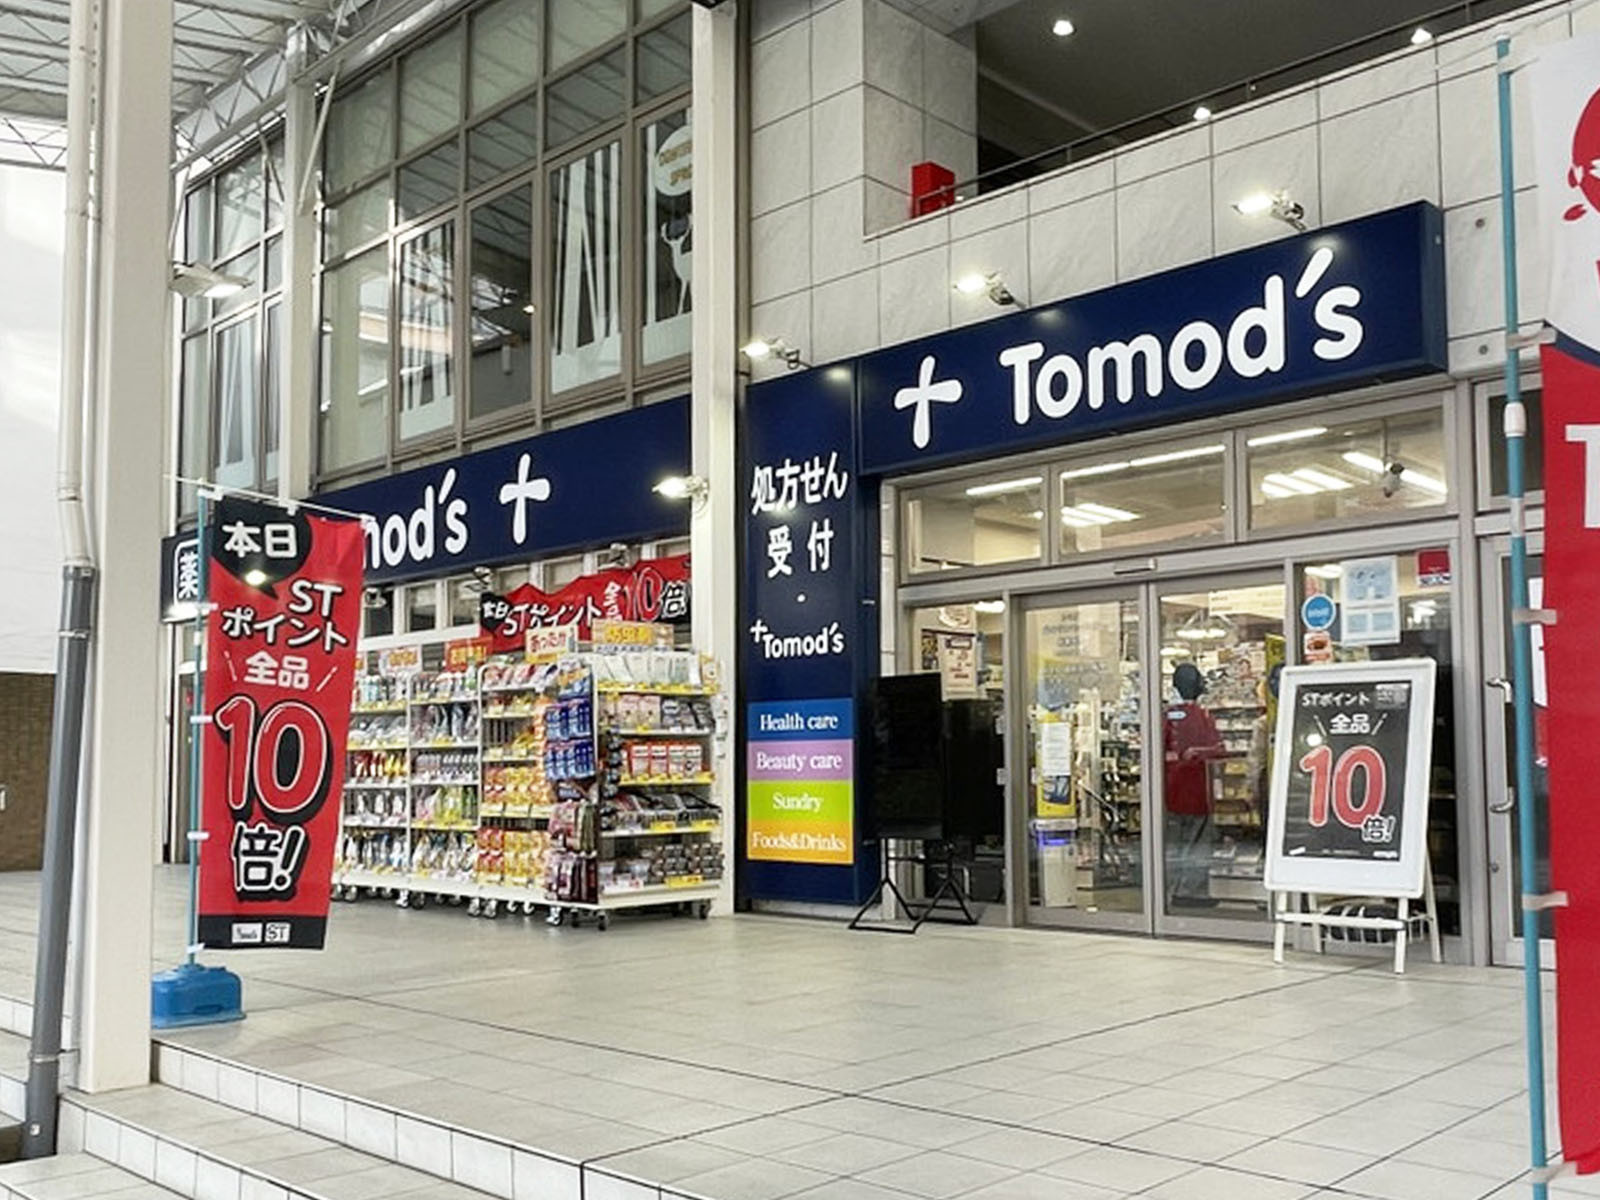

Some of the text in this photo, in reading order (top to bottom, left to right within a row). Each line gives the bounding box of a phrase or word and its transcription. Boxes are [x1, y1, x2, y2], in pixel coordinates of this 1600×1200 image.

[1000, 247, 1364, 425] Tomod's
[751, 451, 848, 516] 処方せん
[221, 520, 298, 559] 本日
[288, 580, 343, 618] ST
[221, 605, 347, 652] ポイント
[762, 621, 844, 659] Tomod's
[243, 650, 310, 691] 全品
[759, 713, 839, 732] Health care
[1328, 712, 1371, 735] 全品
[213, 694, 328, 816] 10
[755, 751, 843, 772] Beauty care
[772, 791, 825, 814] Sundry
[231, 820, 306, 893] 倍!
